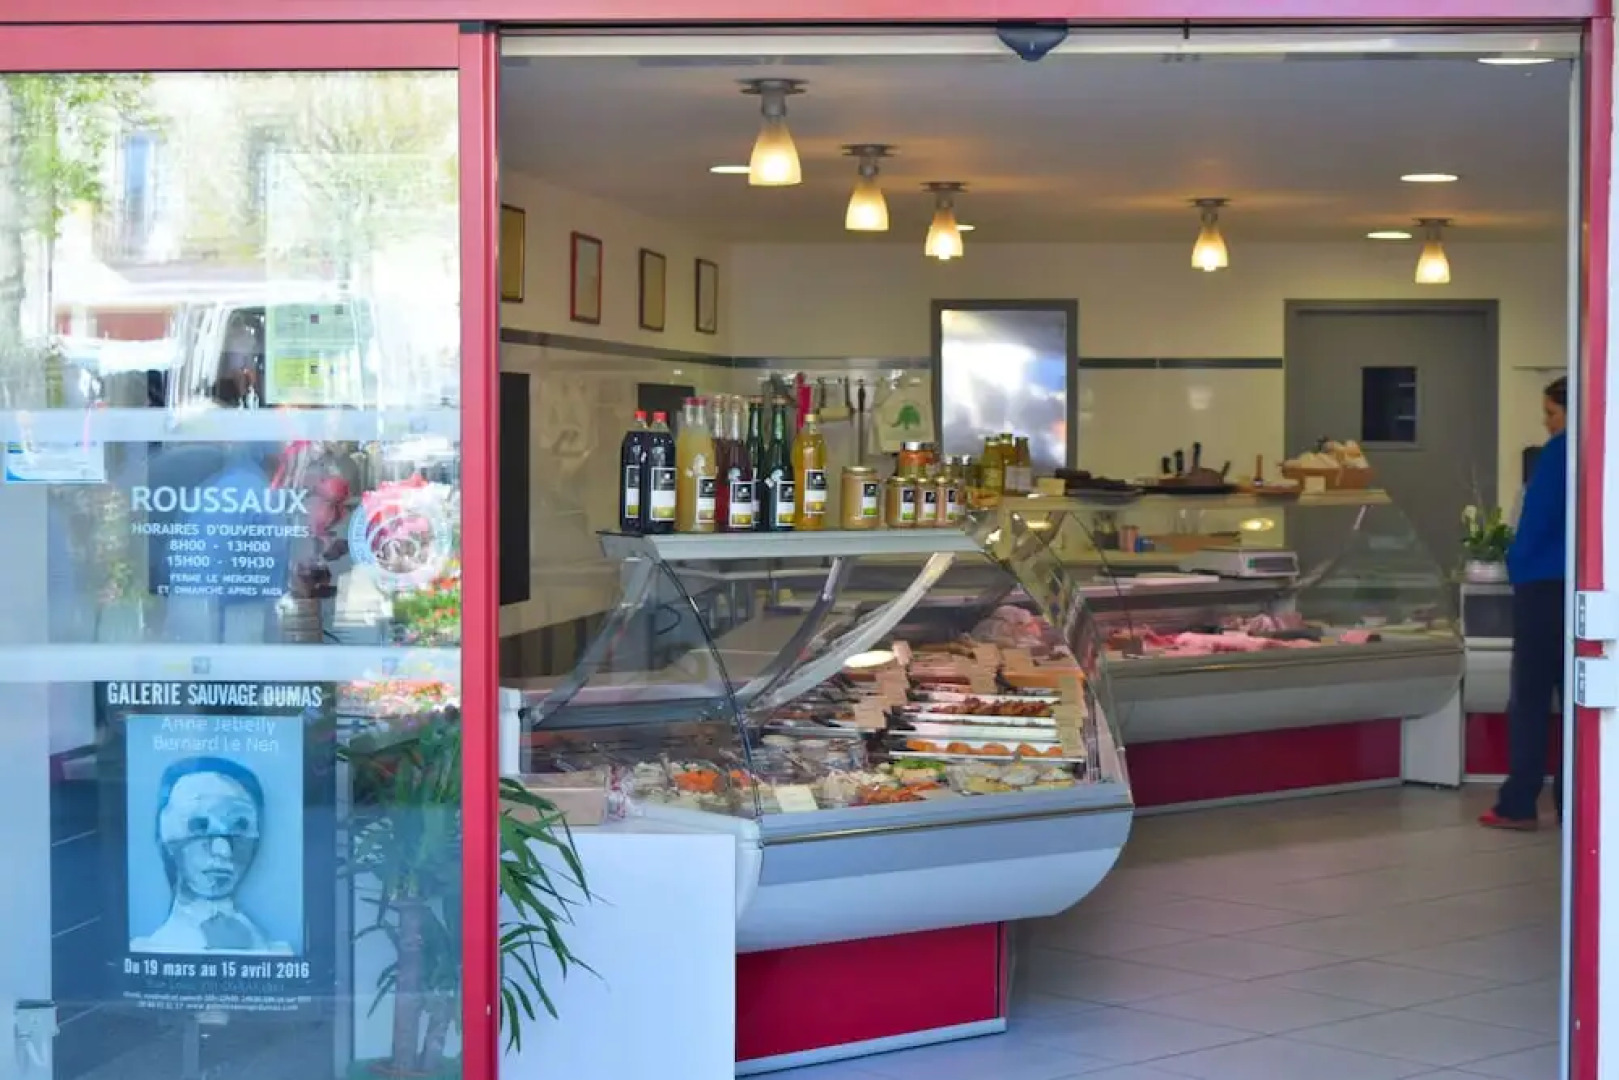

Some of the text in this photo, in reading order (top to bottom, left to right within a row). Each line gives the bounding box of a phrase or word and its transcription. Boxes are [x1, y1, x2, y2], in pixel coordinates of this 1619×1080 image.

[130, 486, 310, 514] ROUSSAUX
[131, 523, 310, 537] HORAIRES D'OUVERTURES
[169, 539, 206, 551] 8H00
[227, 541, 271, 553] 13H00
[167, 555, 210, 567] 15H00
[232, 556, 275, 569] 19H30
[206, 574, 218, 584] LE
[107, 682, 323, 707] GALERIE SAUVAGE DUMAS
[161, 717, 208, 732] Anne
[153, 735, 220, 751] Bernard
[224, 737, 241, 751] Le
[124, 958, 310, 979] Du 19 mars au 15 avril 2016
